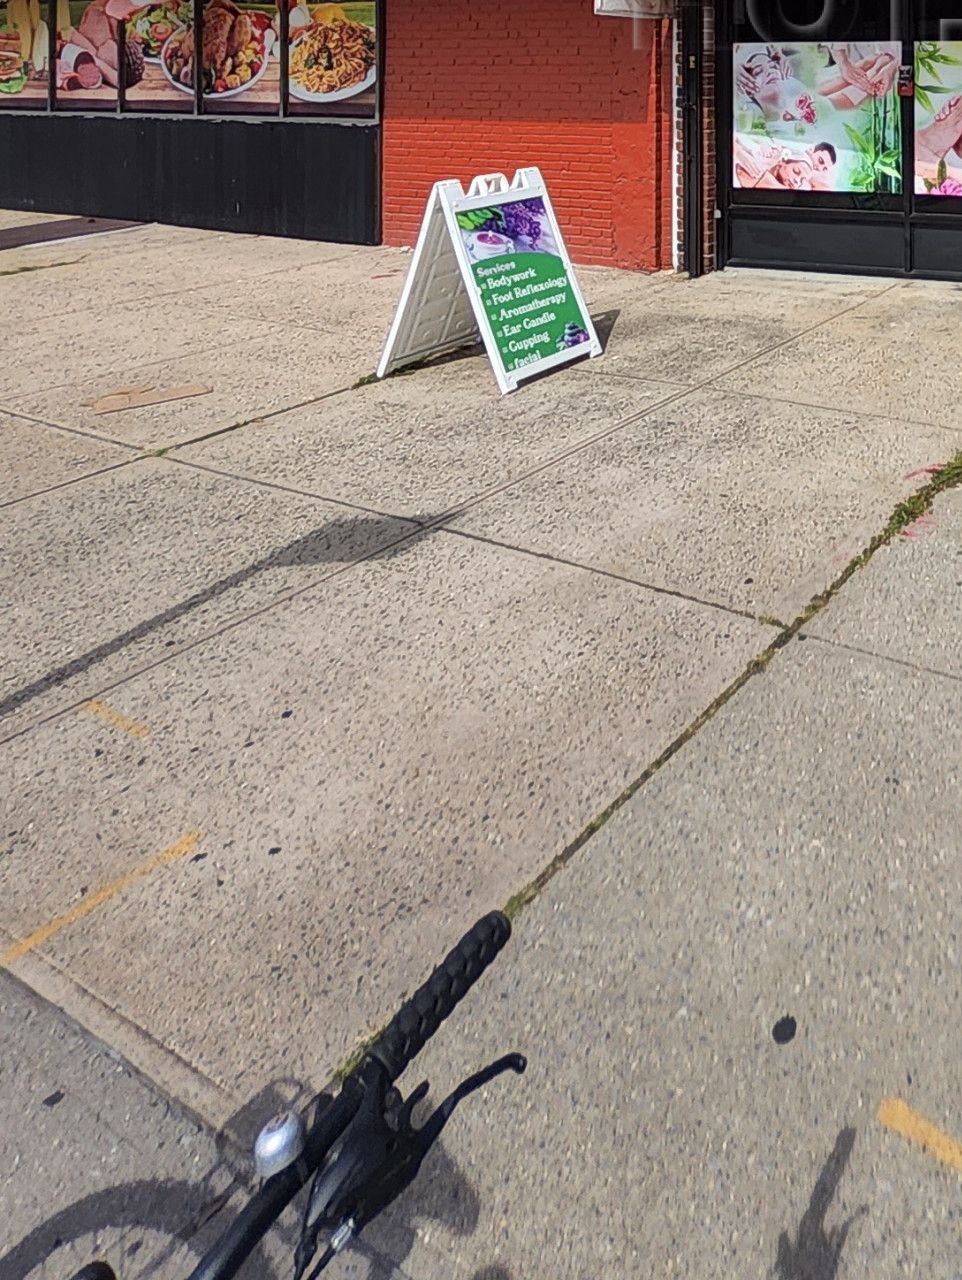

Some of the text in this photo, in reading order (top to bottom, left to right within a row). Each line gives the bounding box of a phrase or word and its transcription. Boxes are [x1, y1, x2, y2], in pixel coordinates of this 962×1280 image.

[476, 261, 516, 277] Services
[486, 267, 537, 289] Bodywork
[492, 276, 567, 305] Foot Reflexology
[499, 292, 566, 321] Aromatherapy
[502, 312, 556, 336] Ear Candle
[514, 349, 542, 369] facial
